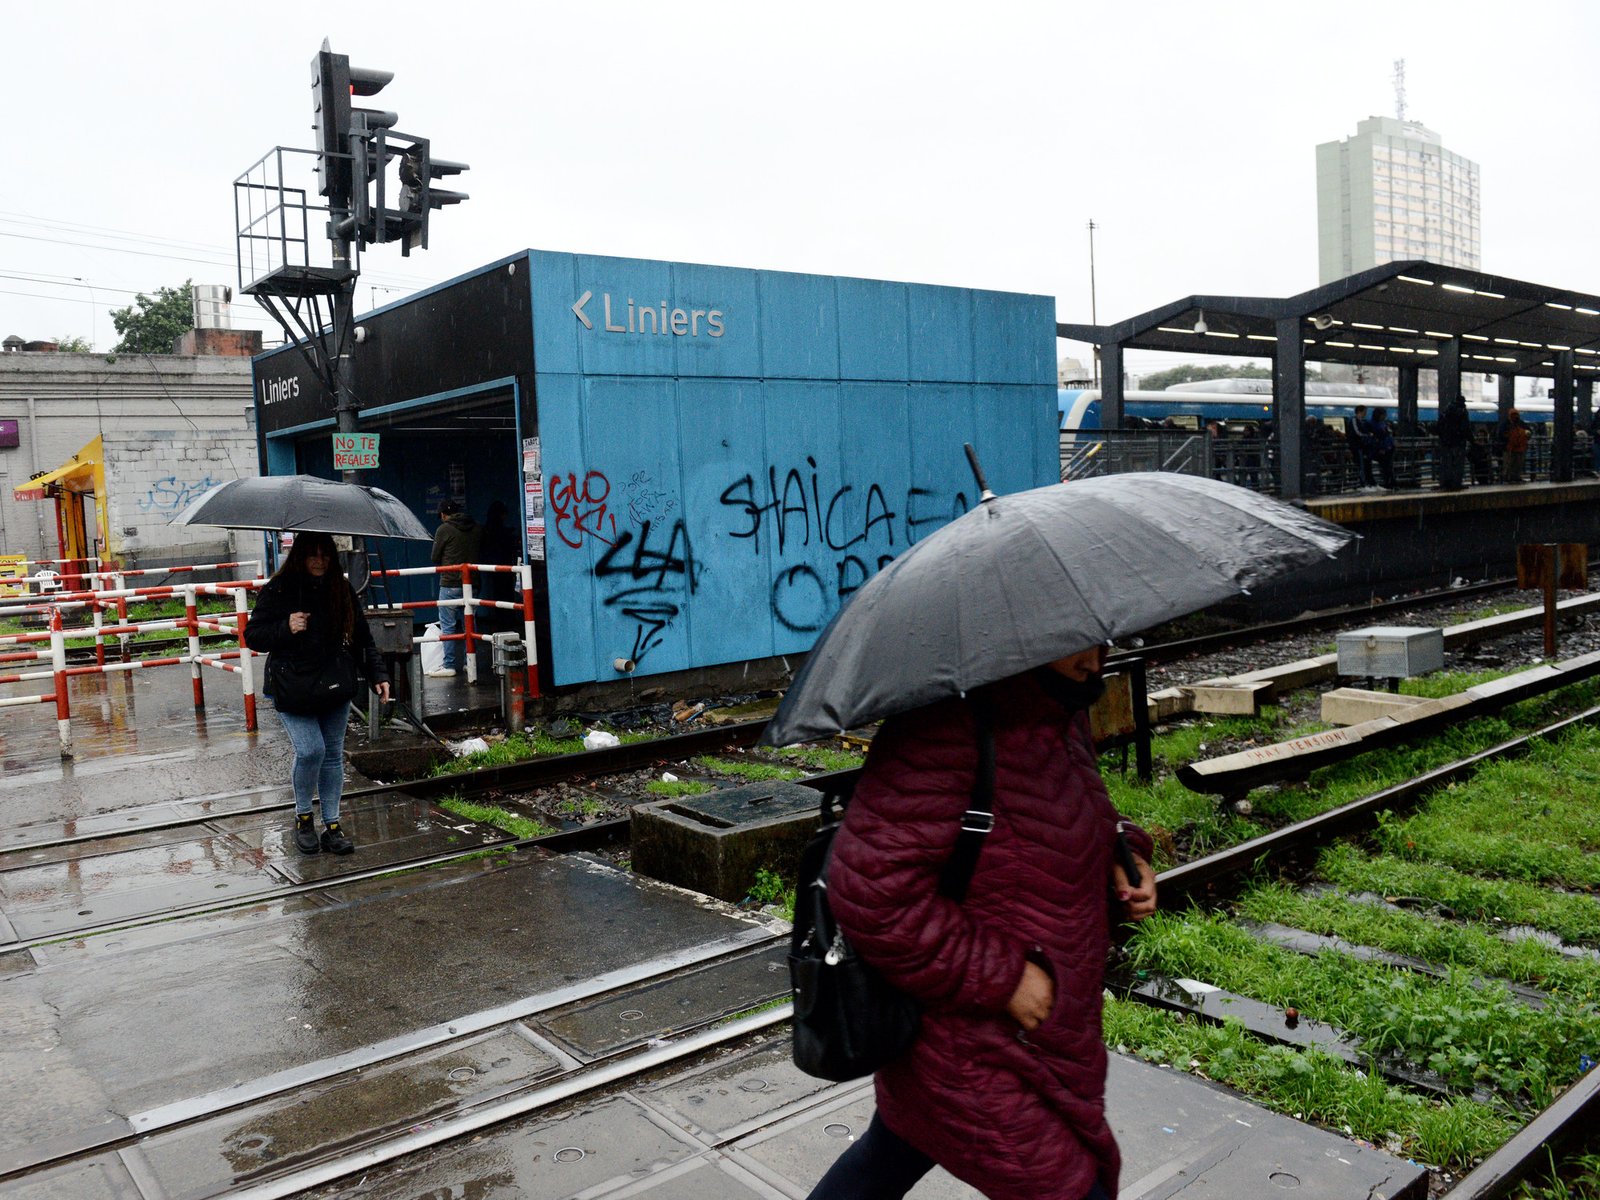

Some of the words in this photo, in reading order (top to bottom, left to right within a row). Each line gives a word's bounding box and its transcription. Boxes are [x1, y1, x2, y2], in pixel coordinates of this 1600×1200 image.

[604, 293, 725, 338] Liniers
[262, 376, 300, 405] Liniers
[335, 437, 354, 450] NO
[361, 437, 375, 450] TE
[335, 454, 377, 467] REGALES
